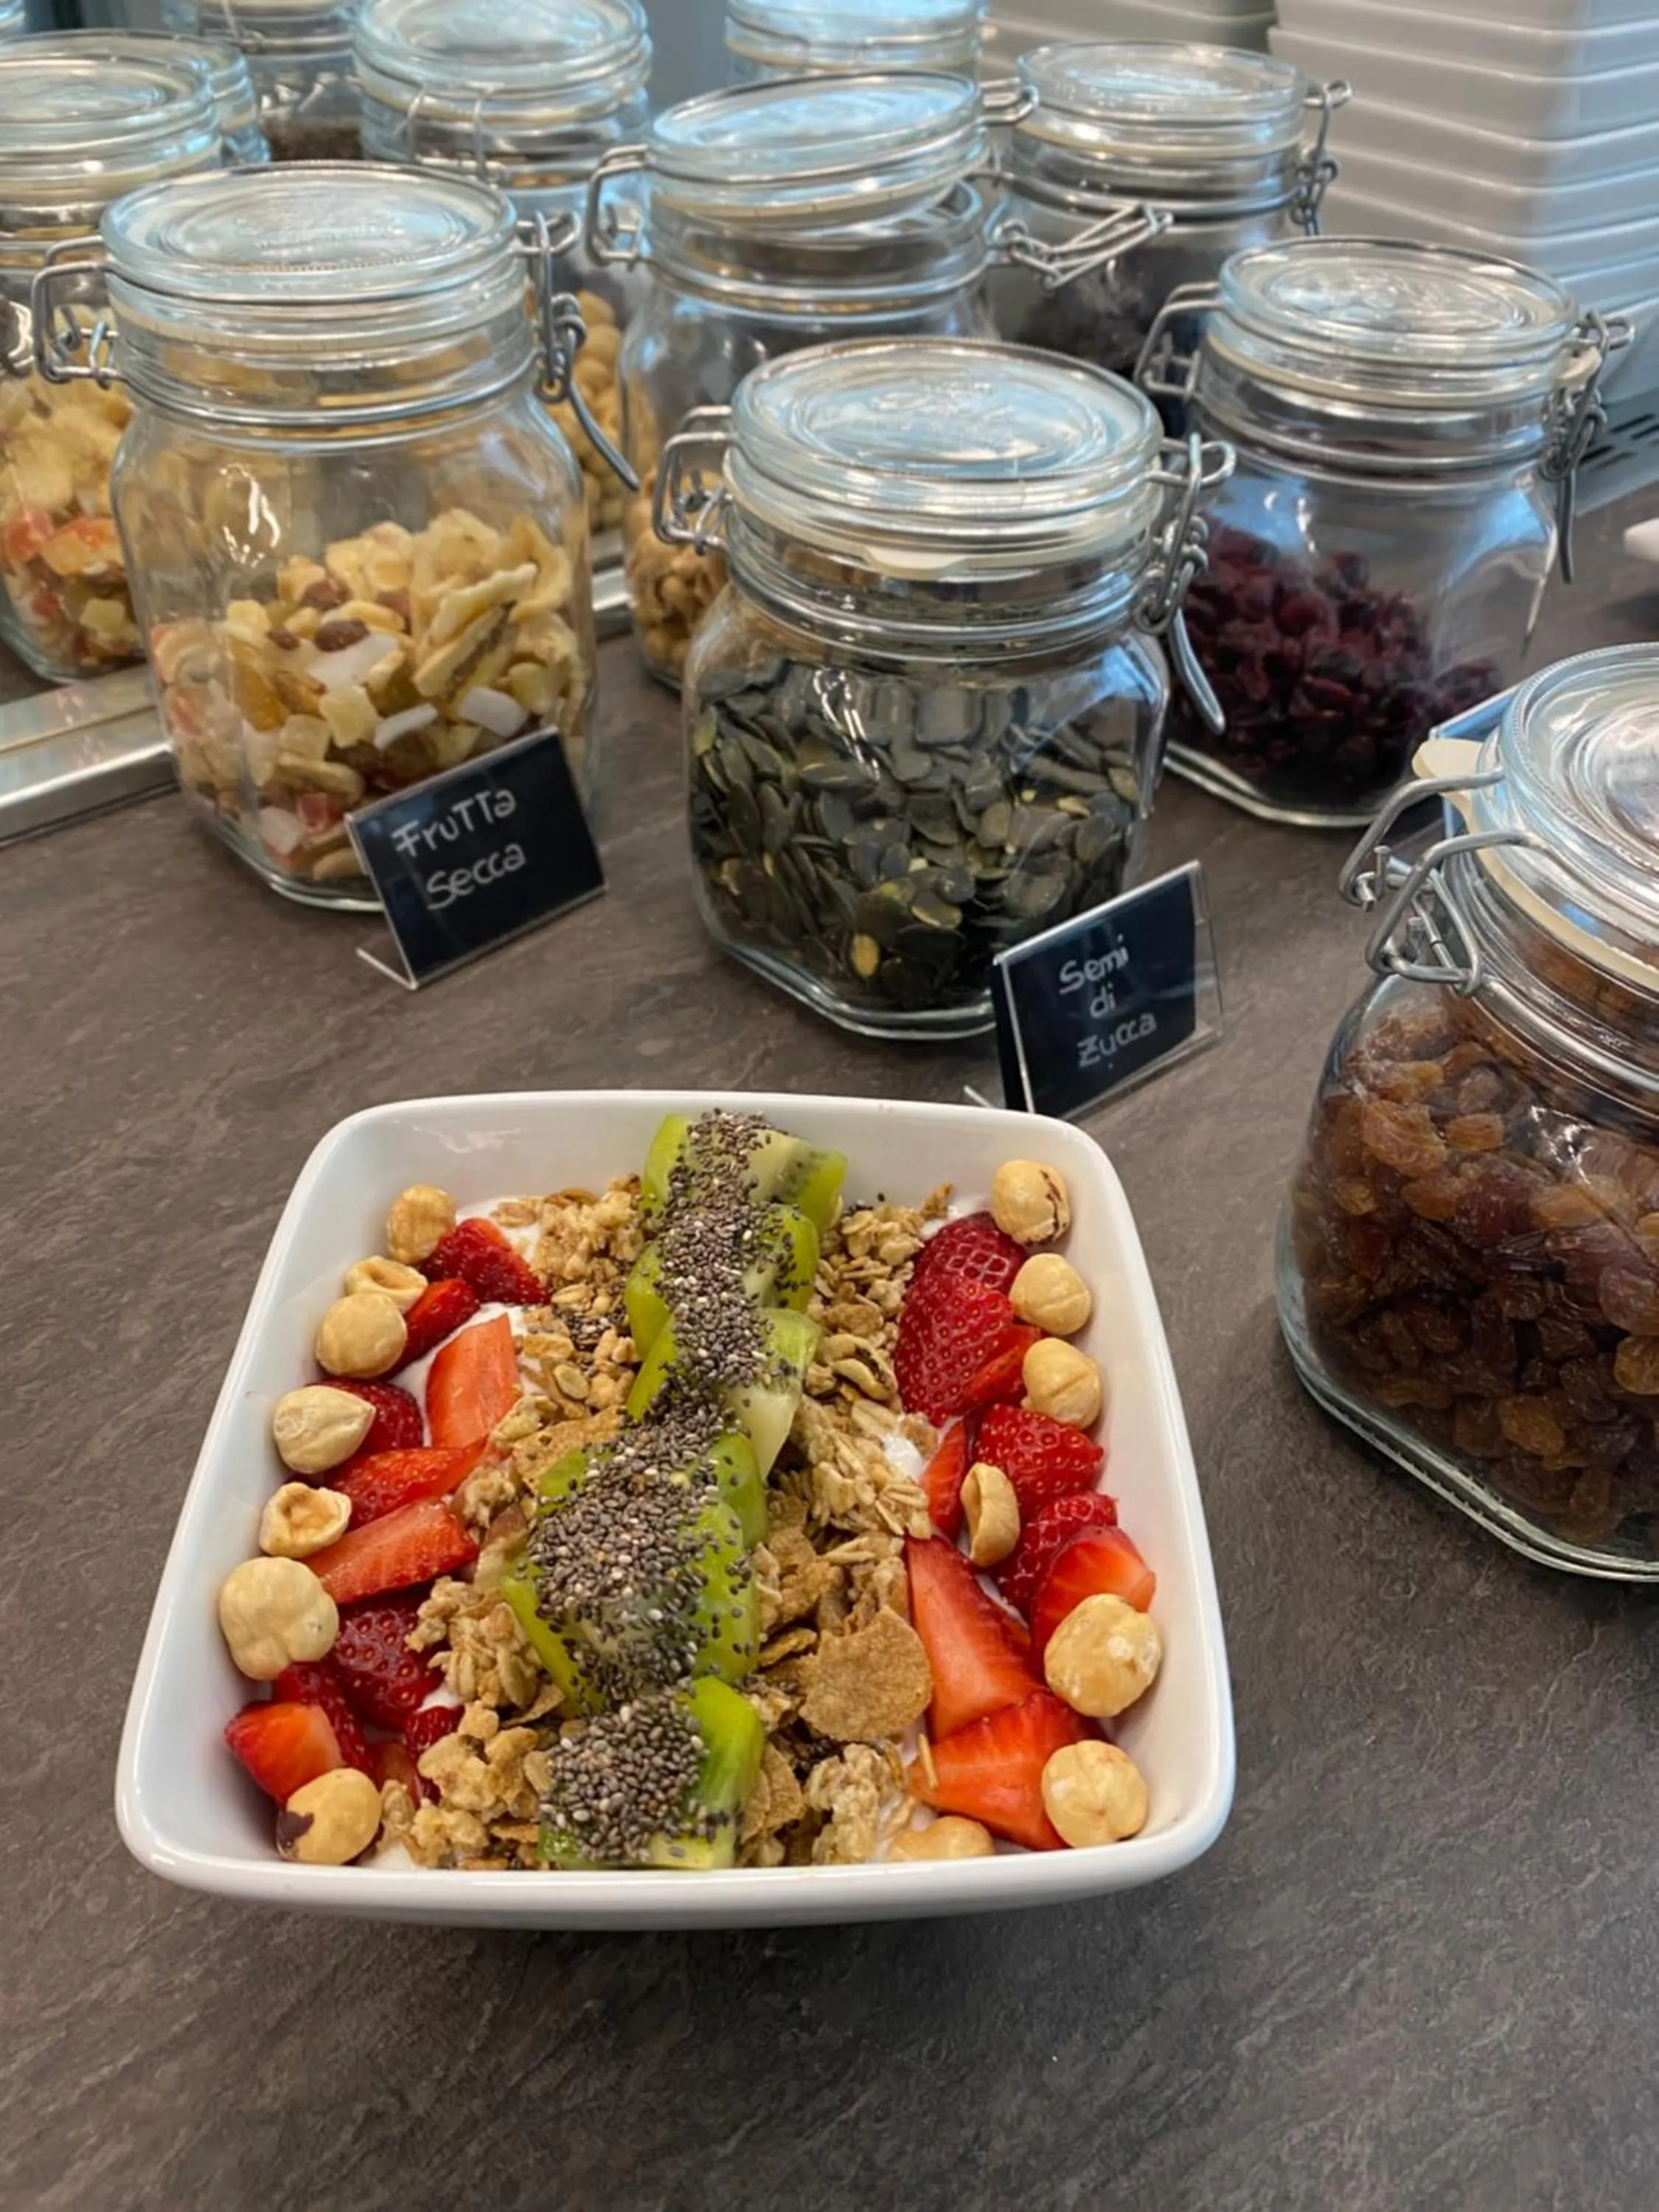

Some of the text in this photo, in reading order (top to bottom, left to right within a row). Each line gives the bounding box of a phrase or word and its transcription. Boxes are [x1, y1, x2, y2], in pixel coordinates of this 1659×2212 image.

[1060, 934, 1130, 994] Semi
[1091, 982, 1116, 1018] di
[1077, 1013, 1157, 1068] Zucca
